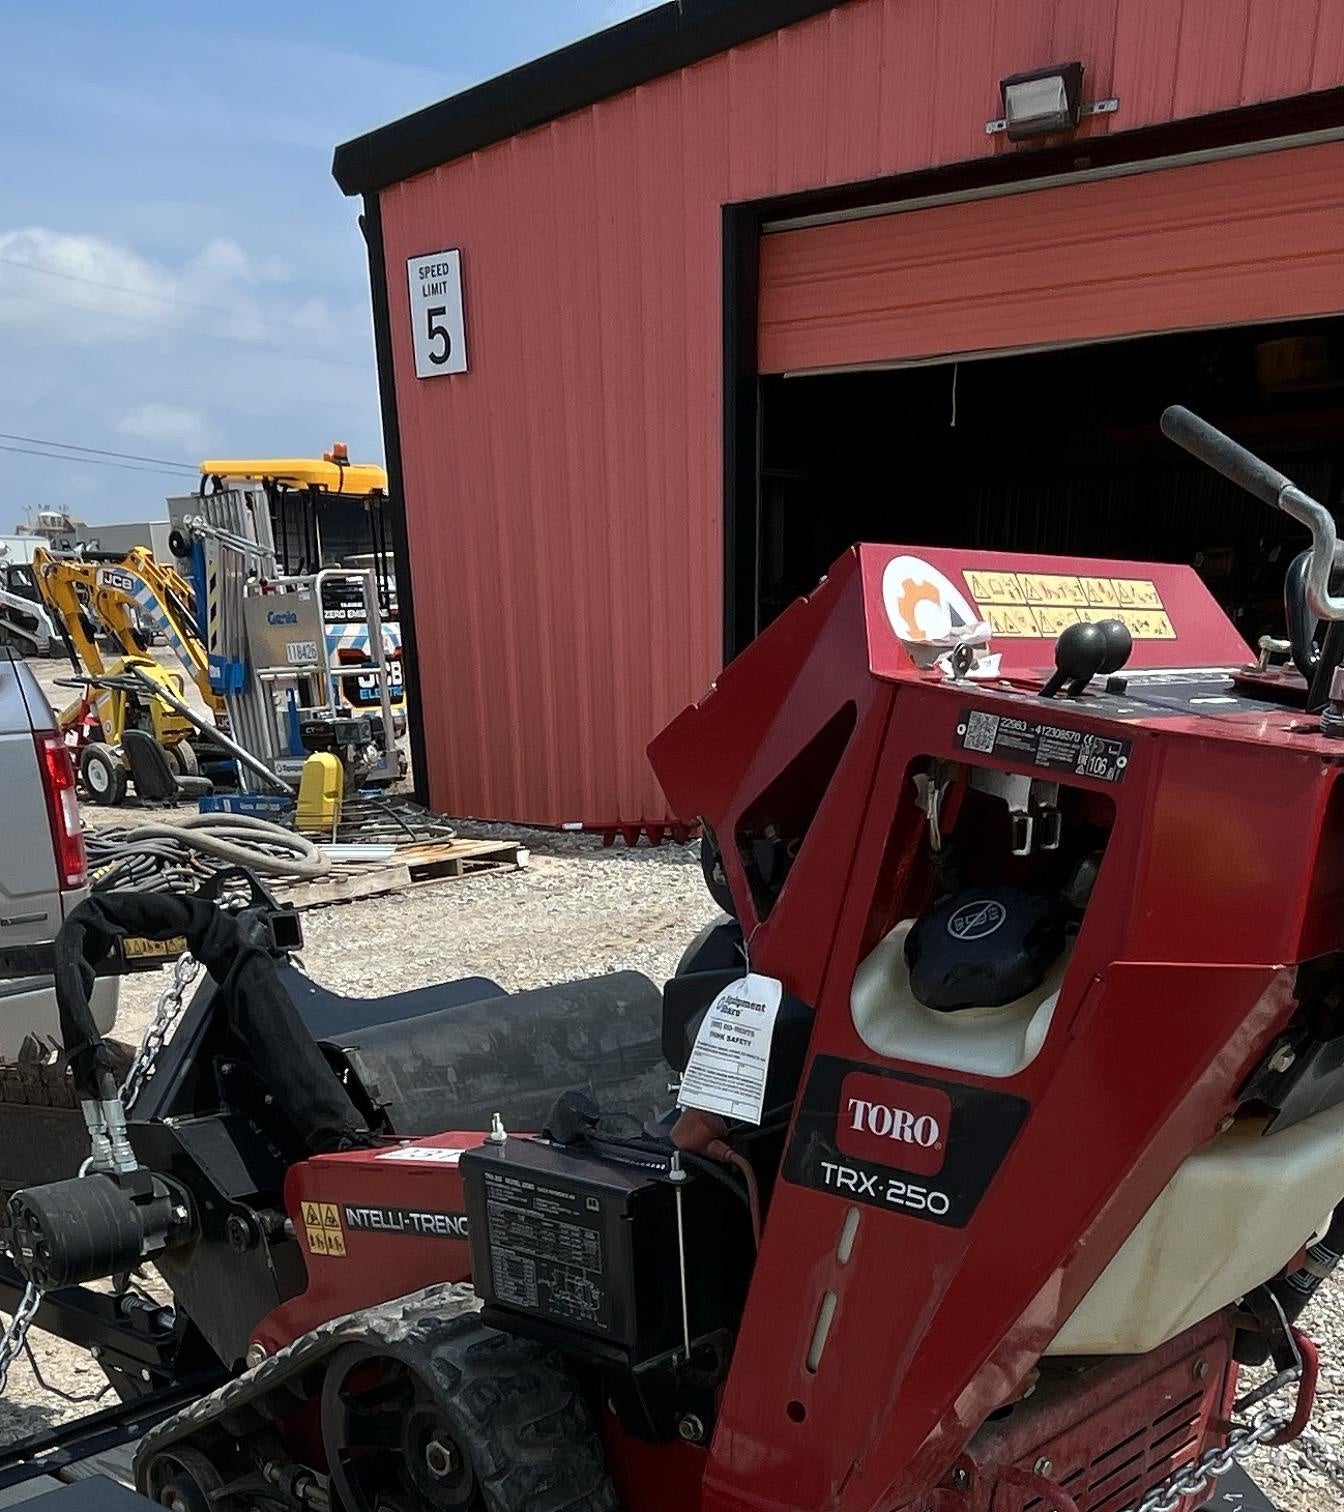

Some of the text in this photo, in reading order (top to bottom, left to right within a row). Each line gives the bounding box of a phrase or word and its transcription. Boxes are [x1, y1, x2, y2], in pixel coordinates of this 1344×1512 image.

[418, 262, 449, 280] SPEED
[422, 281, 448, 298] LIMIT
[427, 306, 451, 365] 5
[104, 573, 133, 590] JCB
[267, 611, 298, 626] Genie
[848, 1098, 940, 1148] TORO
